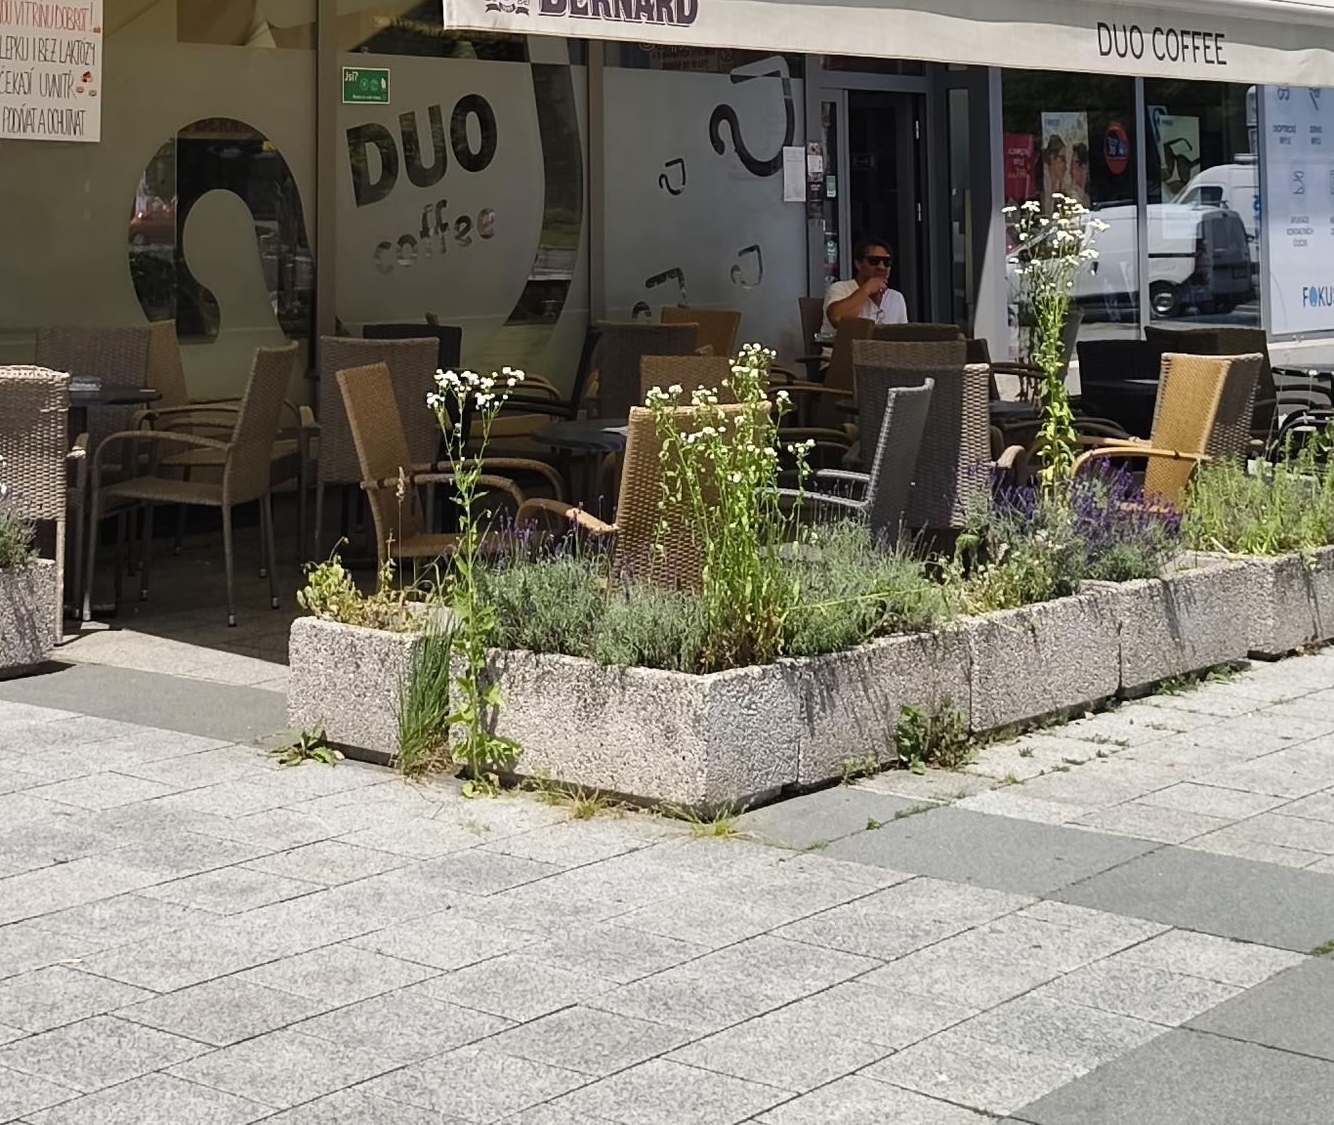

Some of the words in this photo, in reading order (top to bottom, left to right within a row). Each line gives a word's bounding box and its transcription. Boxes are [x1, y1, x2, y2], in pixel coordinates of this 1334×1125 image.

[0, 35, 29, 61] LEPKU
[38, 37, 56, 62] BEZ
[59, 37, 96, 66] LAKTÓZY
[1097, 22, 1144, 60] DUO
[1152, 26, 1227, 65] COFFEE
[38, 108, 46, 134] A
[346, 93, 498, 208] DUO
[373, 199, 496, 275] coffee
